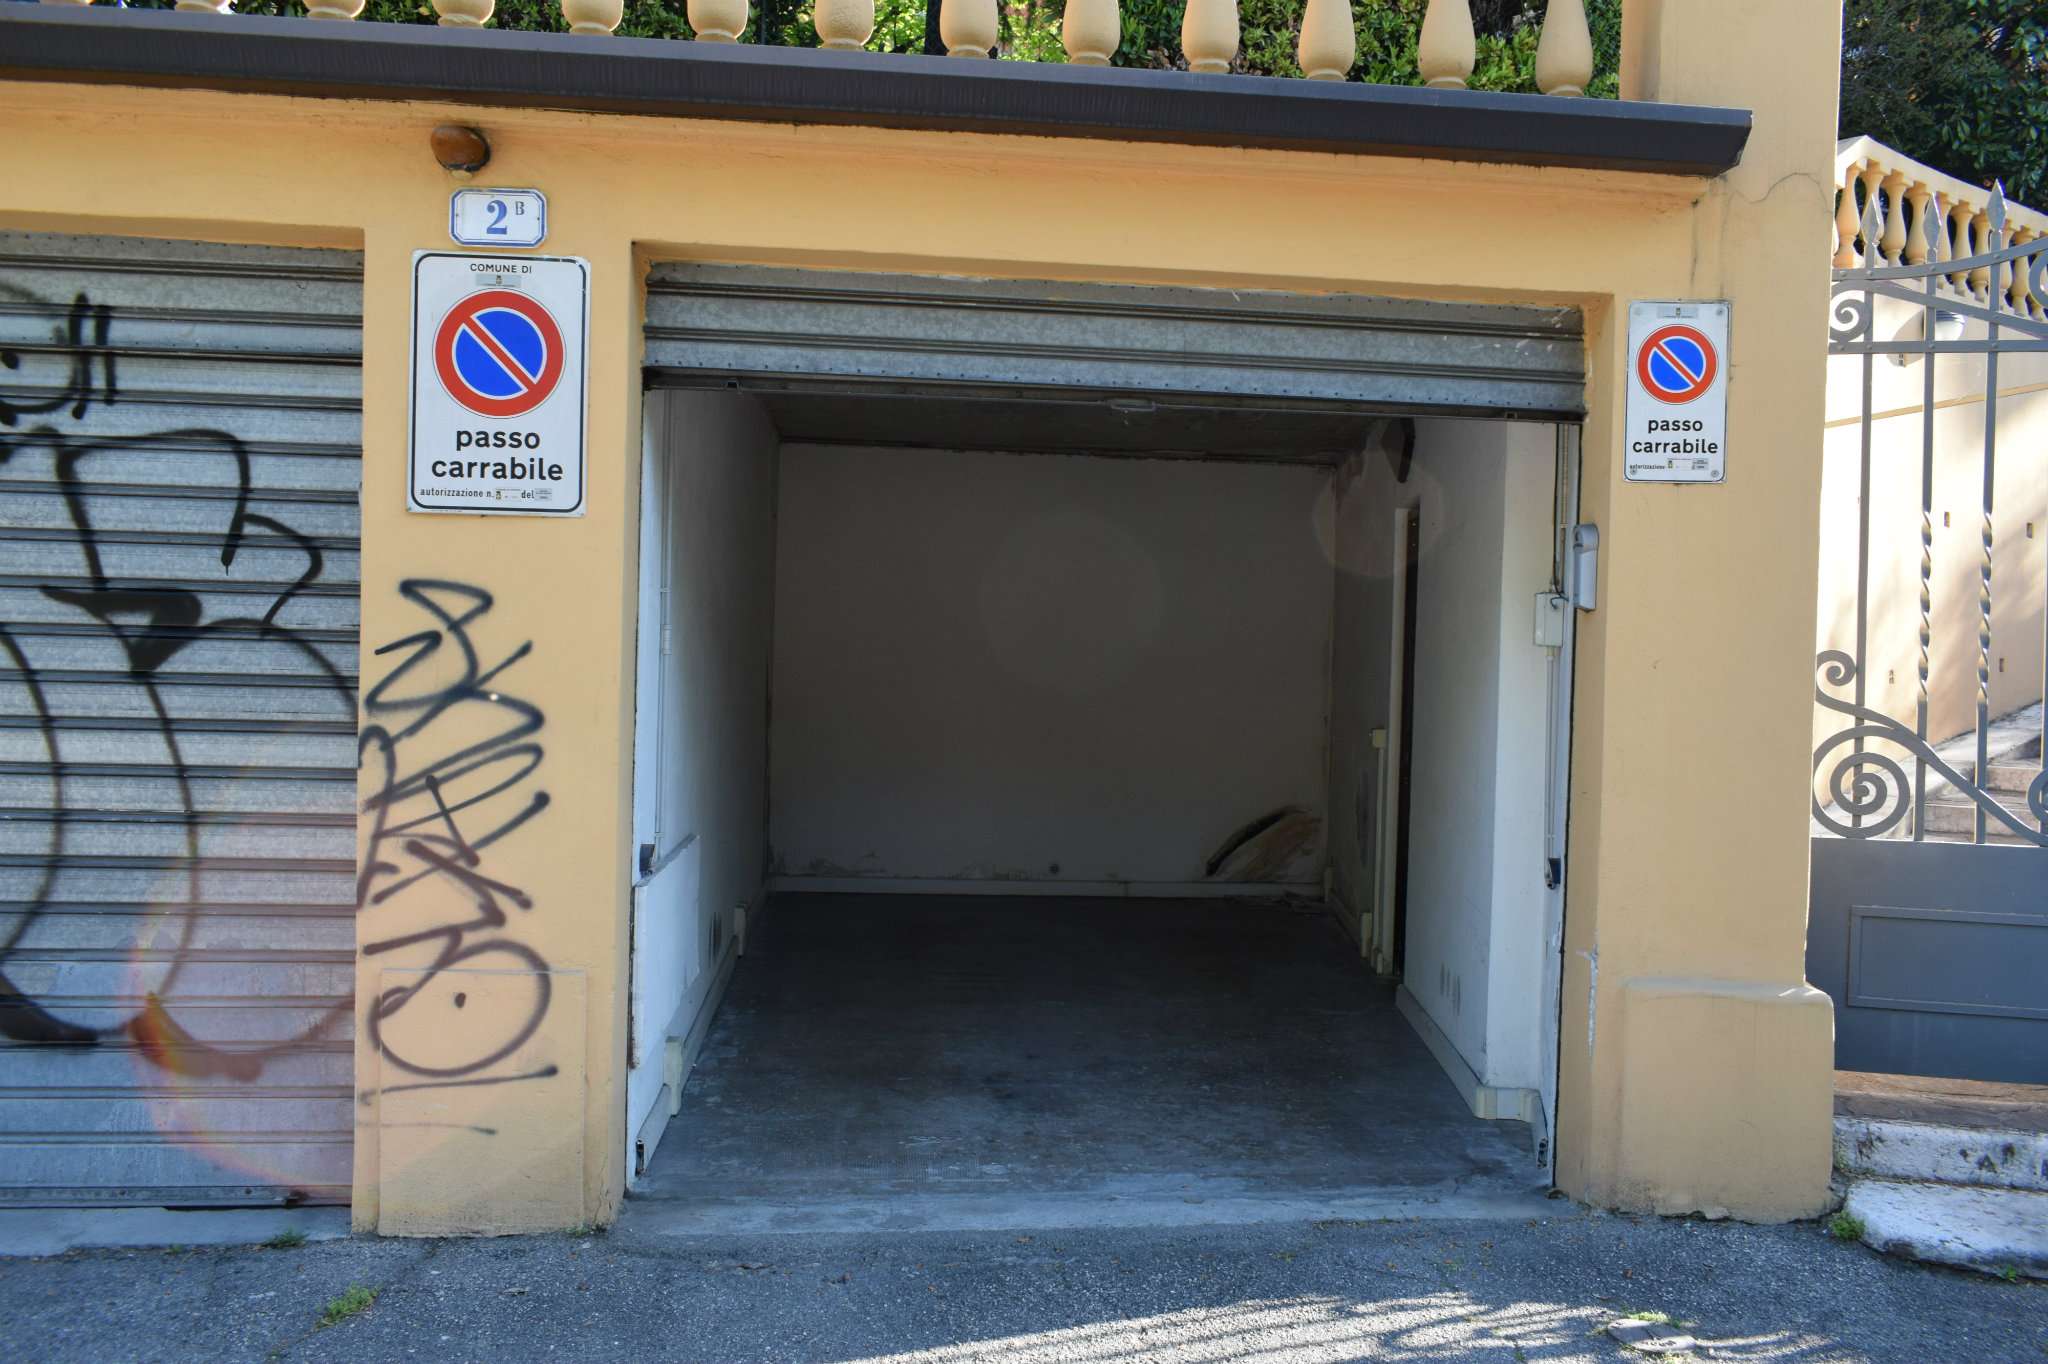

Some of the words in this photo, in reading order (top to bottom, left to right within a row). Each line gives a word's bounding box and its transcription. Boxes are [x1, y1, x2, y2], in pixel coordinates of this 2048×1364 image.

[486, 199, 508, 235] 2
[470, 263, 517, 273] COMUNE
[521, 265, 532, 274] DI
[1648, 419, 1703, 434] passo
[456, 430, 540, 451] passo
[1632, 438, 1718, 454] carrabile
[431, 456, 563, 481] carrabile
[420, 487, 483, 498] autorizzazione
[521, 489, 535, 499] del
